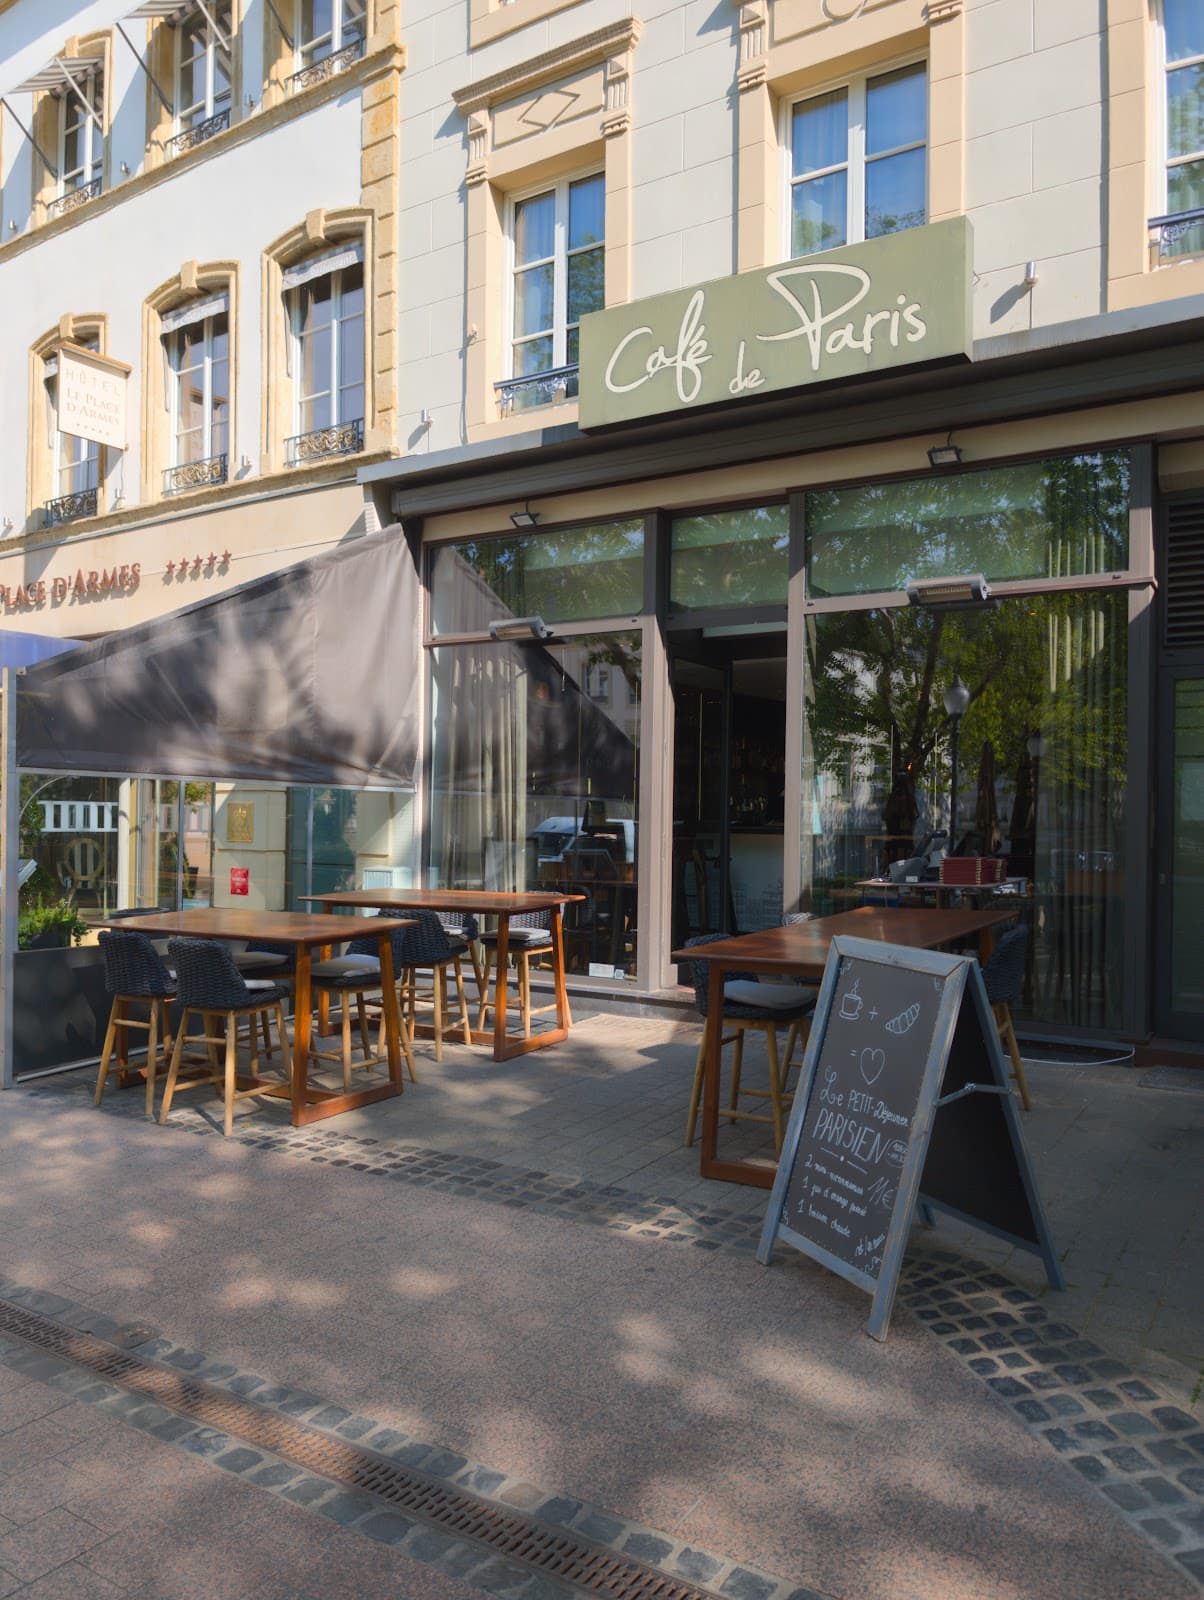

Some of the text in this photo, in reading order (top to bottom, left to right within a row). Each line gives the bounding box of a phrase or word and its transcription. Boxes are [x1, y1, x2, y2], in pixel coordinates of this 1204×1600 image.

[604, 263, 927, 403] Café de Paris
[65, 367, 121, 398] HÔTEL
[52, 562, 141, 598] D'ARMES
[812, 1107, 890, 1165] PARISIEN
